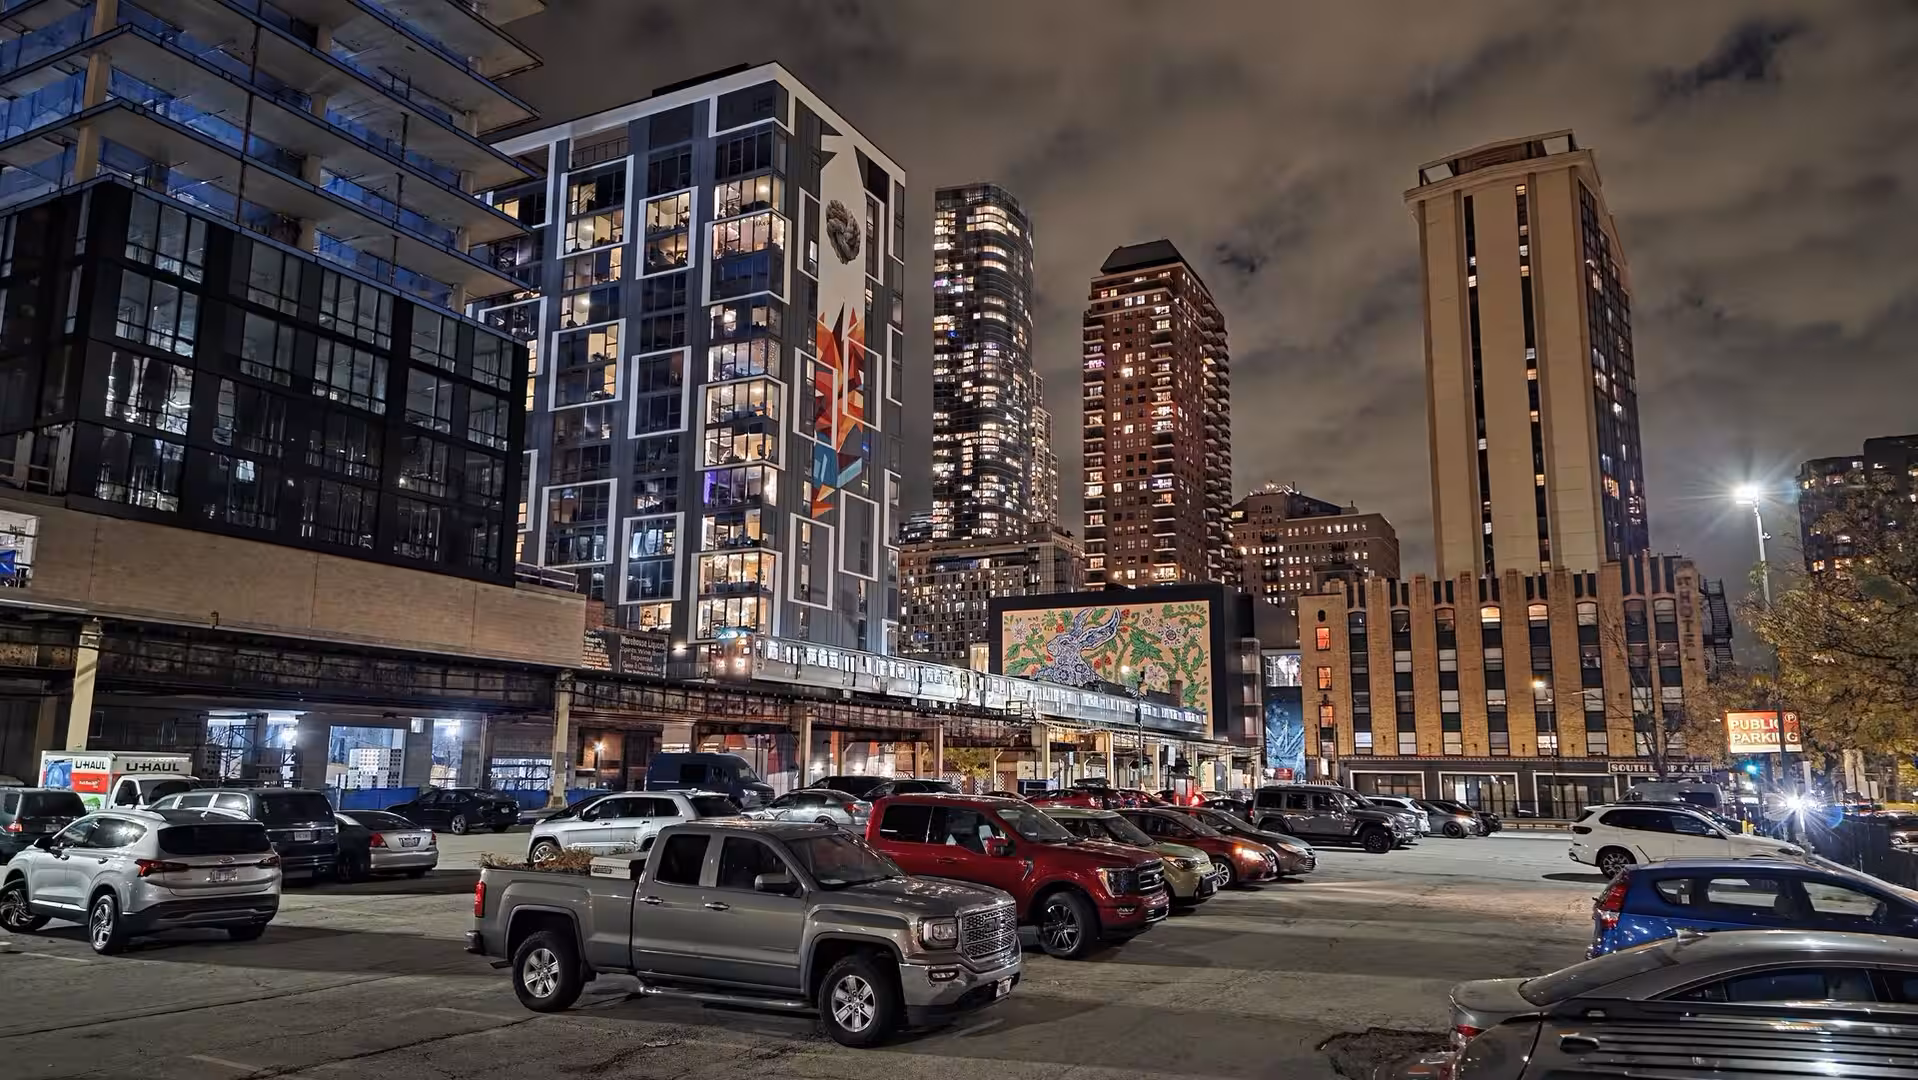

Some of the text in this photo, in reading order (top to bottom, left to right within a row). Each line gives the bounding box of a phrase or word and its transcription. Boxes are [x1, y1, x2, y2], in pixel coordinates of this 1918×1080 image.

[621, 635, 647, 648] Warehouse
[1611, 764, 1710, 772] SOUTH LP CLUB
